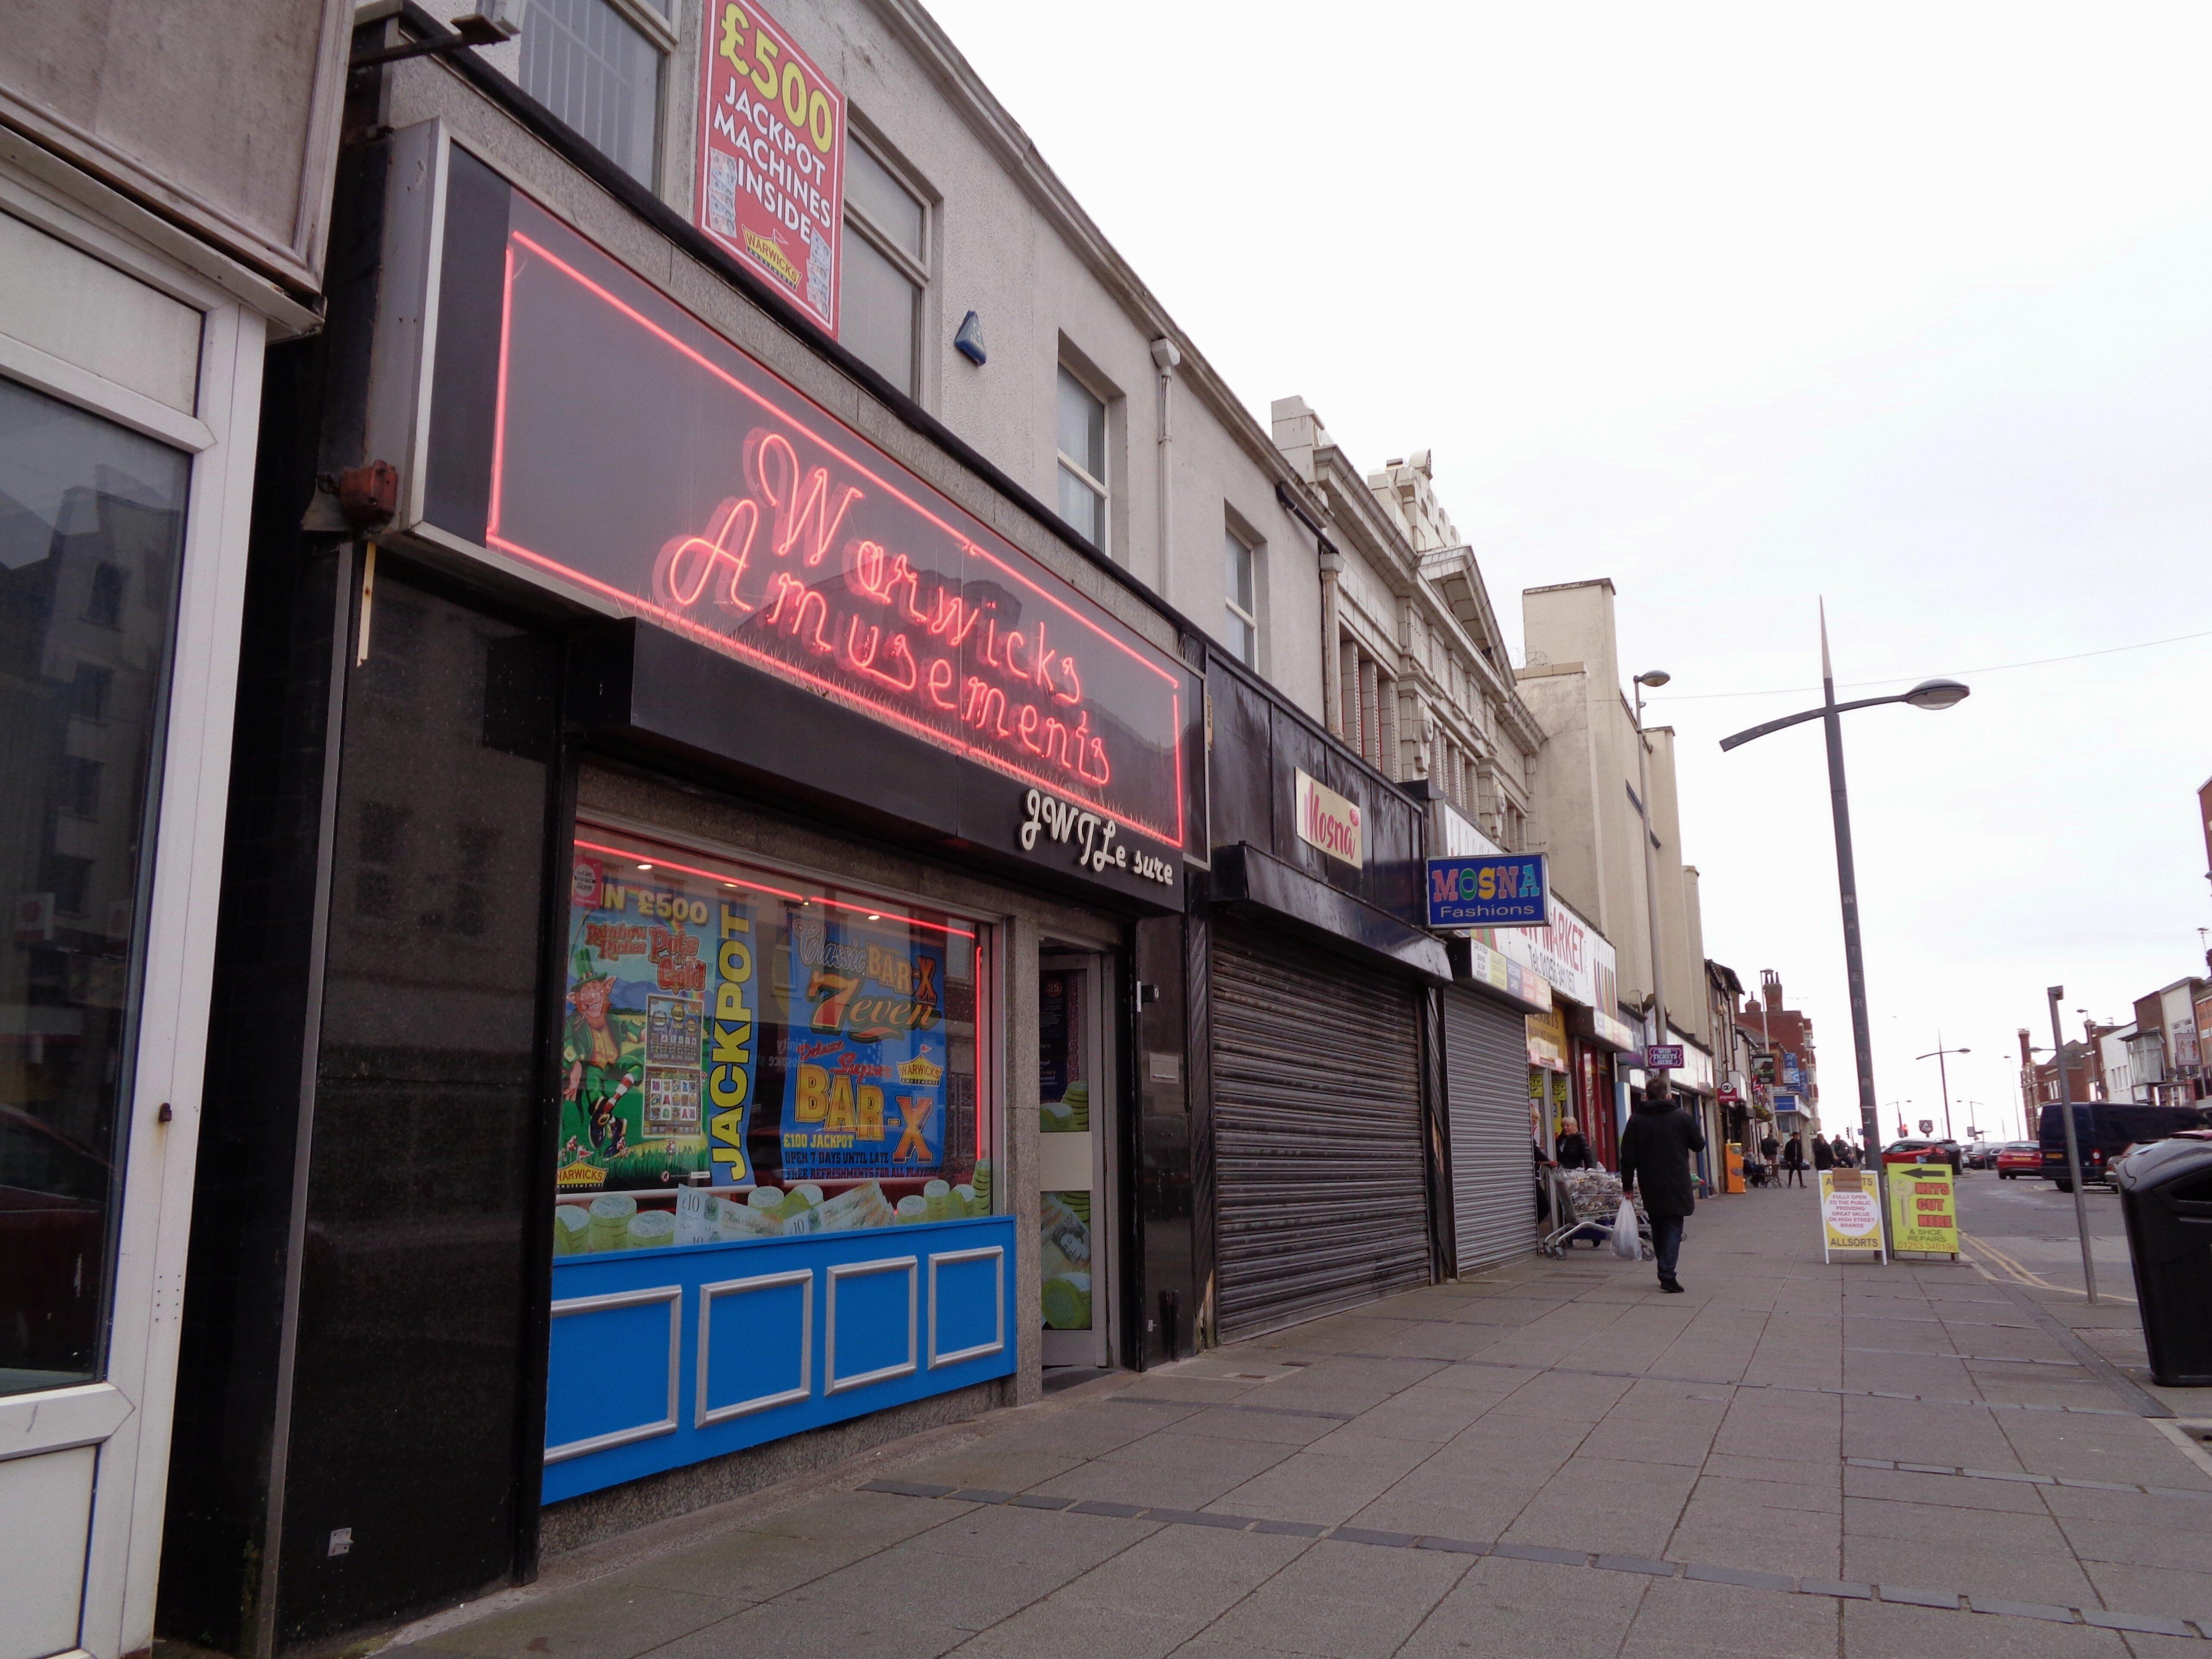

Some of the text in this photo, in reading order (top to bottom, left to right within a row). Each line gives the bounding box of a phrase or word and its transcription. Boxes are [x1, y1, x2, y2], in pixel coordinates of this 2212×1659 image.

[720, 3, 833, 153] £500
[725, 76, 826, 186] JACKPOT
[714, 102, 831, 228] MACHINES
[738, 157, 811, 245] INSIDE
[747, 233, 798, 282] WARWICKS
[758, 433, 1081, 704] Warwicks
[670, 499, 1112, 785] Amusements
[1432, 864, 1540, 902] MOSNA
[637, 889, 708, 925] £500
[1440, 904, 1535, 918] Fashions
[648, 926, 700, 964] Pots
[792, 918, 938, 1005] Classic BAR-X
[657, 955, 707, 995] Gold
[1048, 983, 1059, 993] 25
[709, 903, 752, 1181] JACKPOT
[828, 1052, 893, 1084] Super
[900, 1064, 939, 1079] WARWICKS
[795, 1062, 933, 1164] BAR-X
[783, 1133, 854, 1149] £100 JACKPOT
[785, 1151, 889, 1164] OPEN 7 DAYS UNTIL LATE
[786, 1166, 939, 1180] FREE REFRESHMENTS FOR ALL PLAYERS
[1915, 1182, 1950, 1195] KEYS
[681, 1194, 700, 1213] £10
[1916, 1198, 1945, 1211] CUT
[1918, 1214, 1953, 1228] HERE
[1831, 1238, 1878, 1247] ALLSORTS
[1898, 1241, 1923, 1250] 01253
